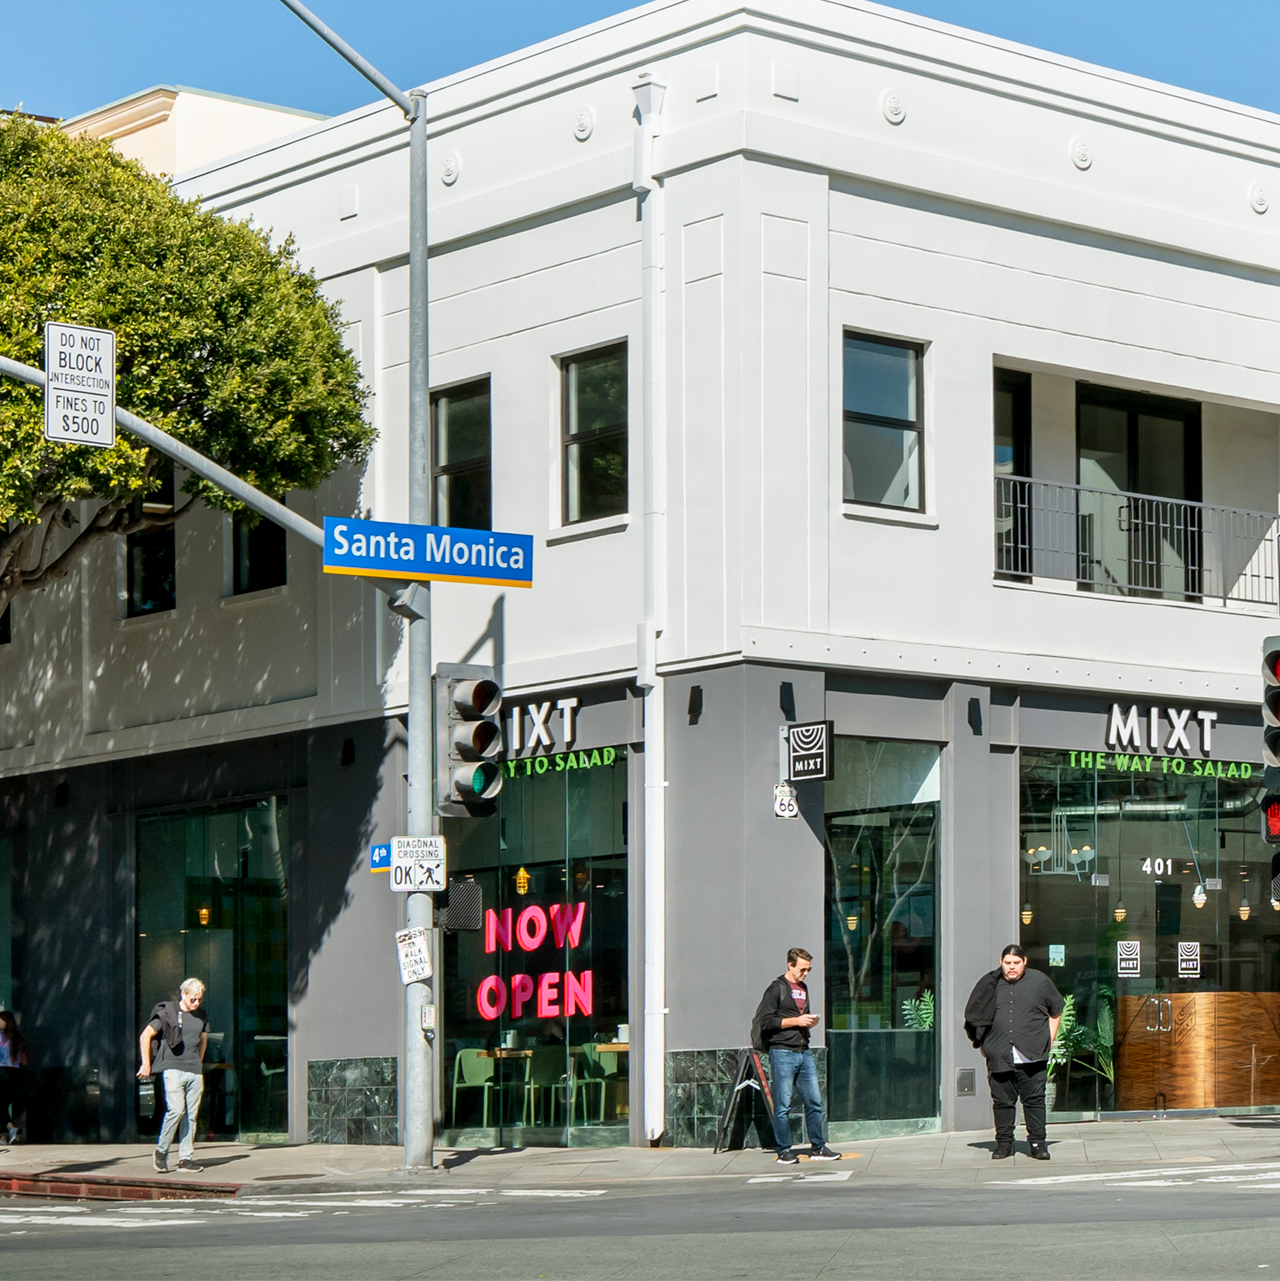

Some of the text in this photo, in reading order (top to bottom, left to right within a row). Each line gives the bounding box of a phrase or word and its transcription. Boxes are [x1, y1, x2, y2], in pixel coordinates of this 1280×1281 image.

[61, 333, 101, 352] DO NOT
[59, 351, 102, 374] BLOCK
[51, 372, 110, 390] INTERSECTION
[56, 395, 106, 415] FINES TO
[62, 414, 99, 435] $500
[334, 525, 524, 569] Santa Monica
[511, 697, 578, 750] IXT
[1106, 702, 1218, 756] MIXT
[524, 756, 548, 775] TO
[555, 747, 616, 772] SALAD
[795, 758, 822, 772] MIXT
[1069, 751, 1252, 779] THE WAY TO SALAD
[779, 798, 795, 812] 66
[397, 840, 439, 849] DIAGONAL
[373, 847, 387, 863] 4th
[397, 850, 439, 859] CROSSING
[394, 865, 413, 885] OK
[1142, 857, 1172, 875] 401
[484, 901, 586, 954] NOW
[404, 947, 423, 959] WALK
[402, 957, 428, 971] SIGNAL
[407, 966, 426, 979] ONLY
[1120, 960, 1138, 968] MIXT
[1180, 960, 1198, 969] MIXT
[476, 970, 593, 1021] OPEN
